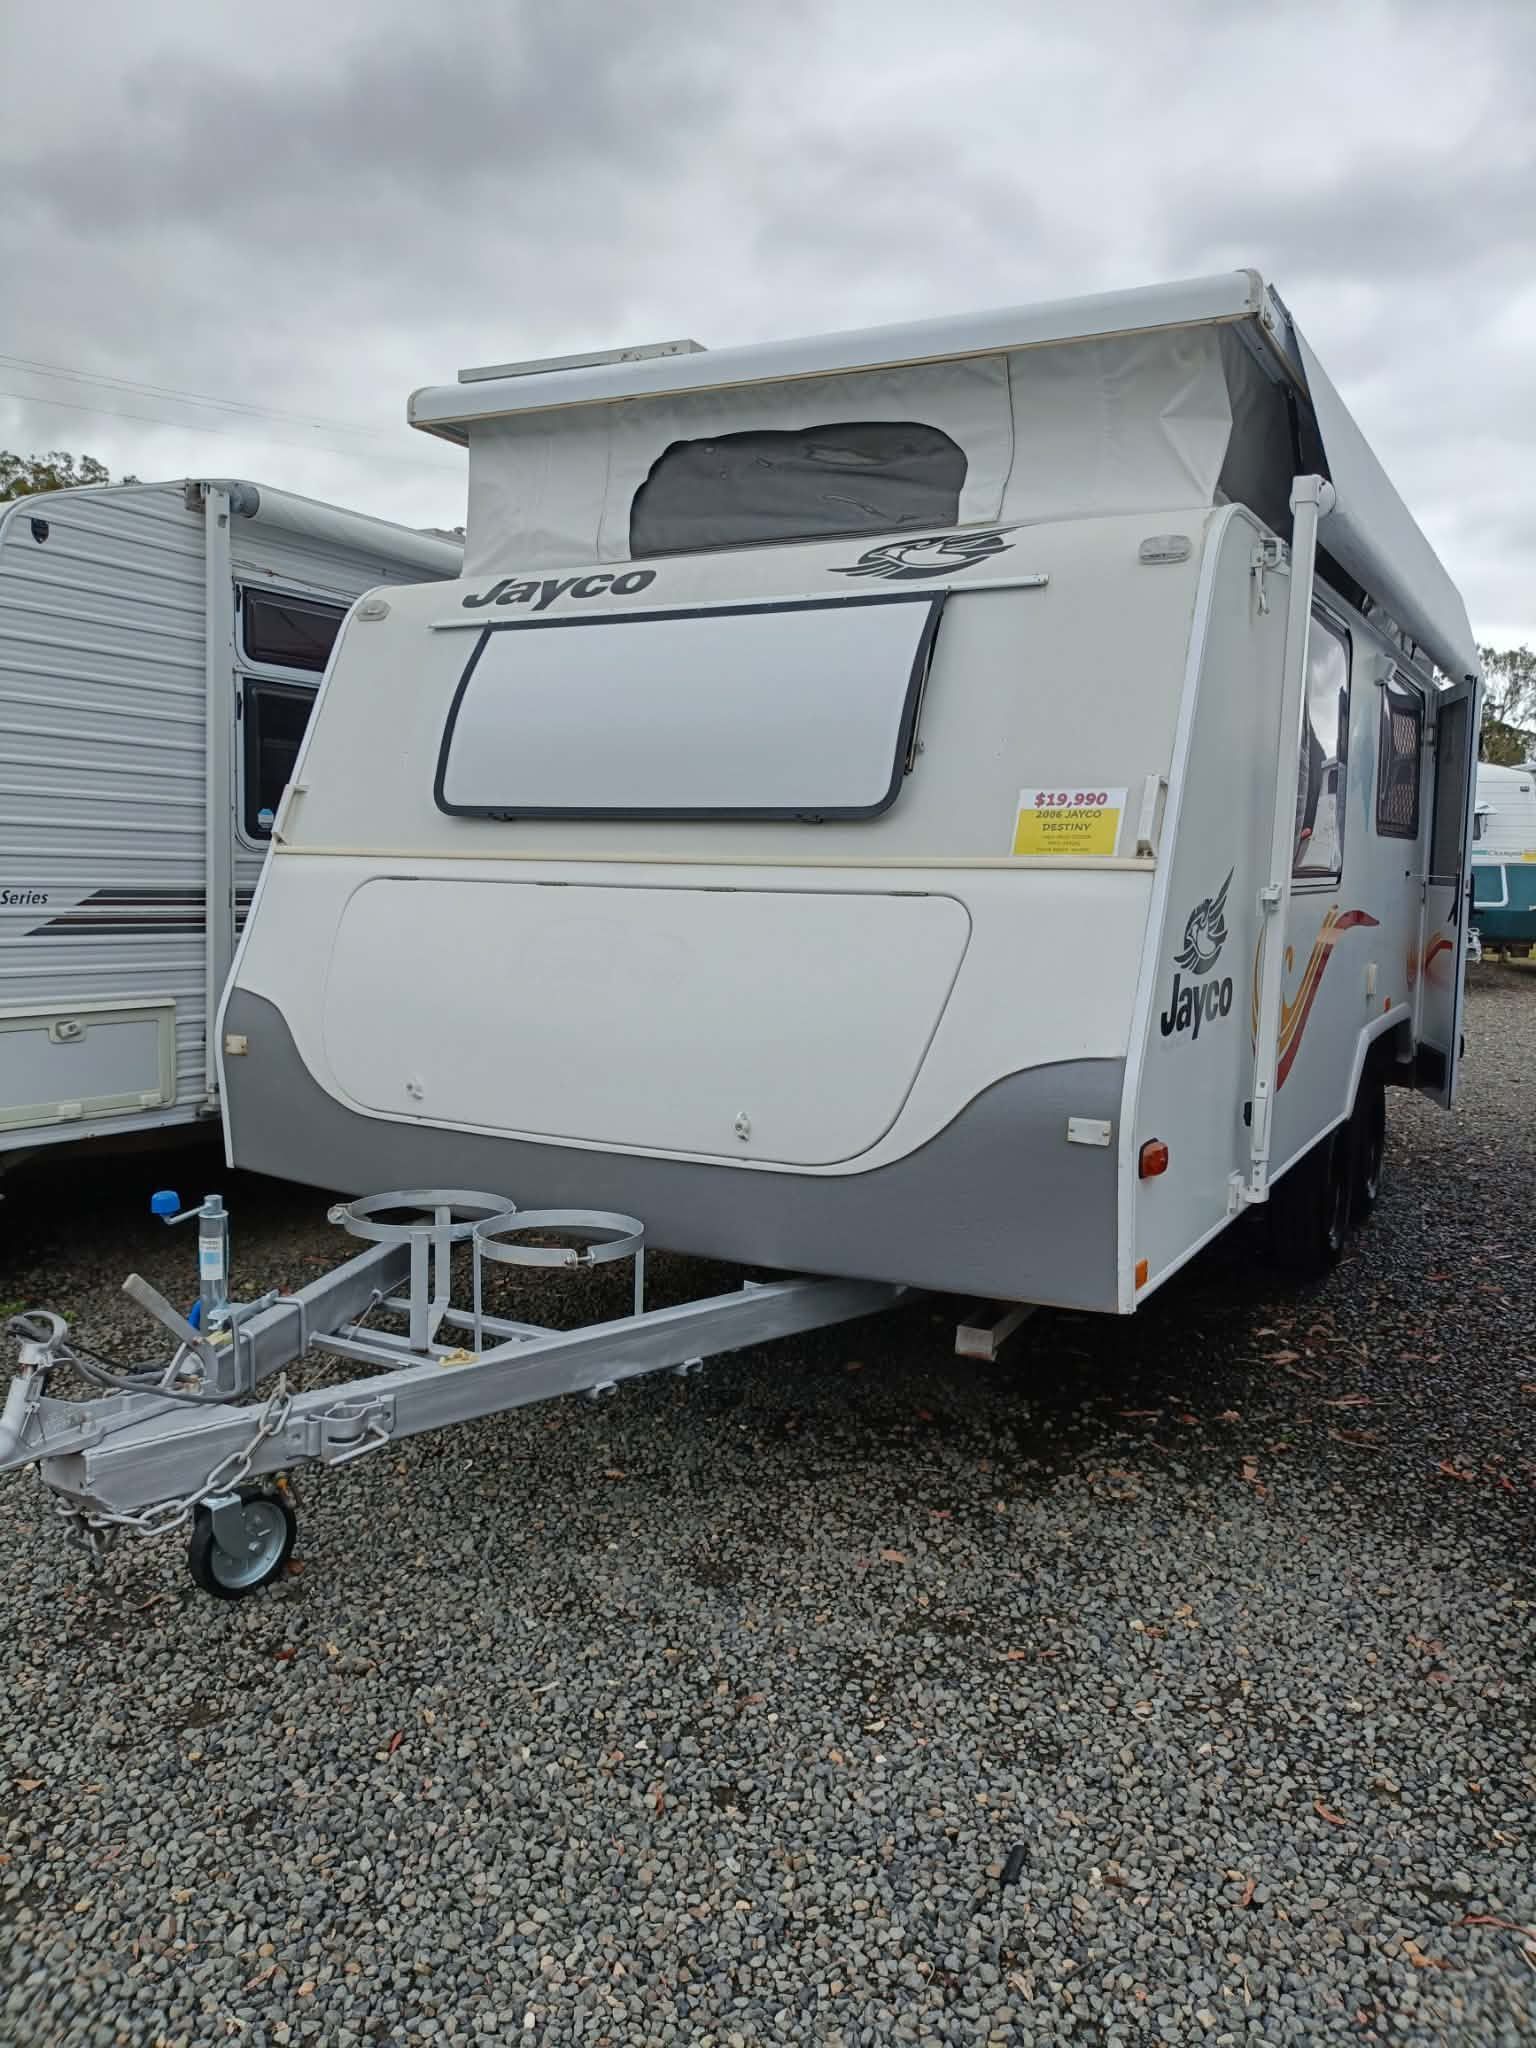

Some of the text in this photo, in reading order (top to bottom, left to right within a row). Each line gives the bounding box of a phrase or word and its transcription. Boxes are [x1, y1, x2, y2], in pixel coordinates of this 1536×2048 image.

[462, 570, 656, 611] Jayco
[1034, 792, 1108, 808] $19,990
[1036, 809, 1102, 818] 2006 JAYCO
[1042, 823, 1091, 831] DESTINY
[0, 890, 48, 904] Series
[1161, 973, 1233, 1040] Jayco
